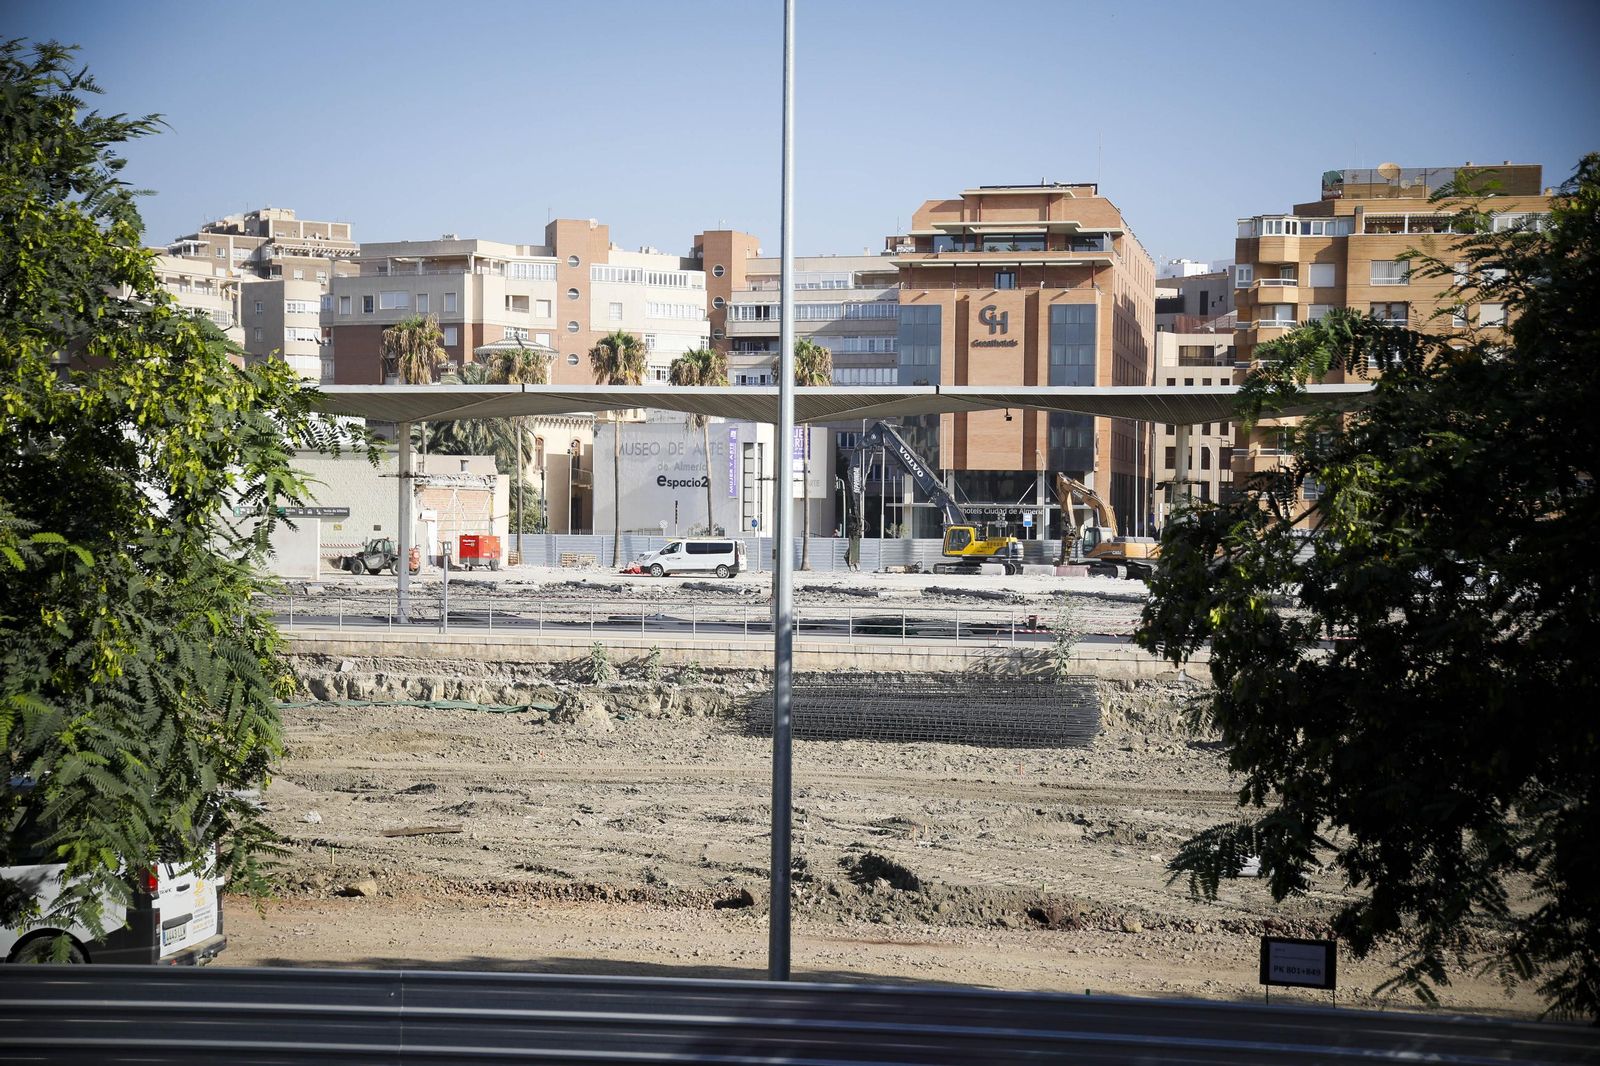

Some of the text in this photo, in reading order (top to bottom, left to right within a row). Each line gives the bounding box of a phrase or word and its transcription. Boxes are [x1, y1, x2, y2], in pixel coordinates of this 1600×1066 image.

[668, 442, 684, 456] DE
[899, 445, 924, 478] VOLVO
[656, 475, 709, 490] espacio2
[984, 507, 1007, 515] Ciudad
[1274, 964, 1284, 973] PK
